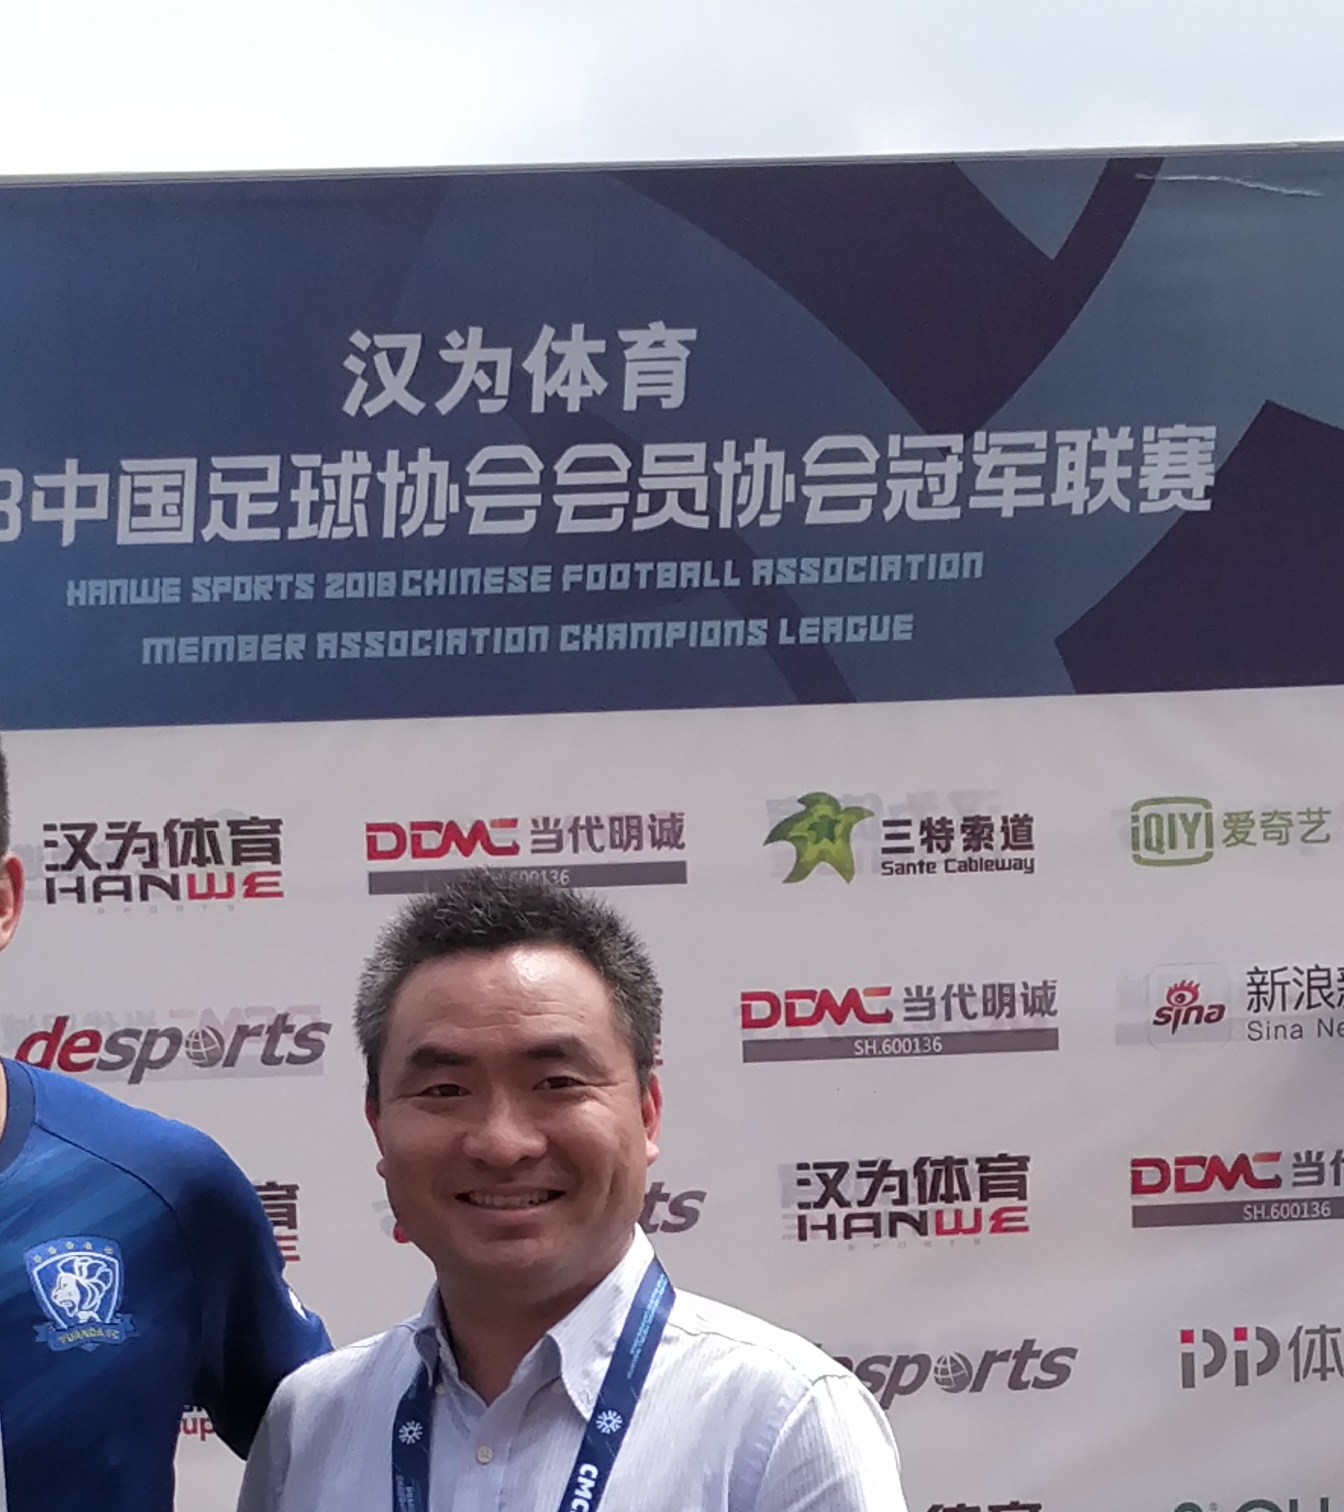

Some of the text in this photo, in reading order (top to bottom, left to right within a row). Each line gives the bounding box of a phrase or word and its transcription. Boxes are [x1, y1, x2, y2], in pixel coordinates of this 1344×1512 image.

[342, 321, 698, 418] 汉为体育
[66, 551, 985, 606] HANWE SPORTS 2018 CHINESE FOOTBALL ASSOCIATION
[142, 613, 914, 664] MEMBER ASSOCIATION CHAMPIONS LEAGUE
[42, 816, 284, 872] 汉为体育
[365, 812, 687, 861] DDMC 当代明诚
[881, 813, 1036, 856] 三特索道
[44, 870, 285, 904] HANWE
[881, 855, 1036, 877] Sante Cableway
[740, 979, 1059, 1030] DDMC 当代明诚
[1152, 988, 1226, 1035] sina
[853, 1035, 943, 1056] SH.600136
[1247, 1019, 1304, 1041] Sina
[795, 1152, 1031, 1209] 汉为体育
[1130, 1151, 1283, 1195] DDMC
[796, 1206, 1030, 1242] HANWE
[1242, 1200, 1332, 1222] SH.600136
